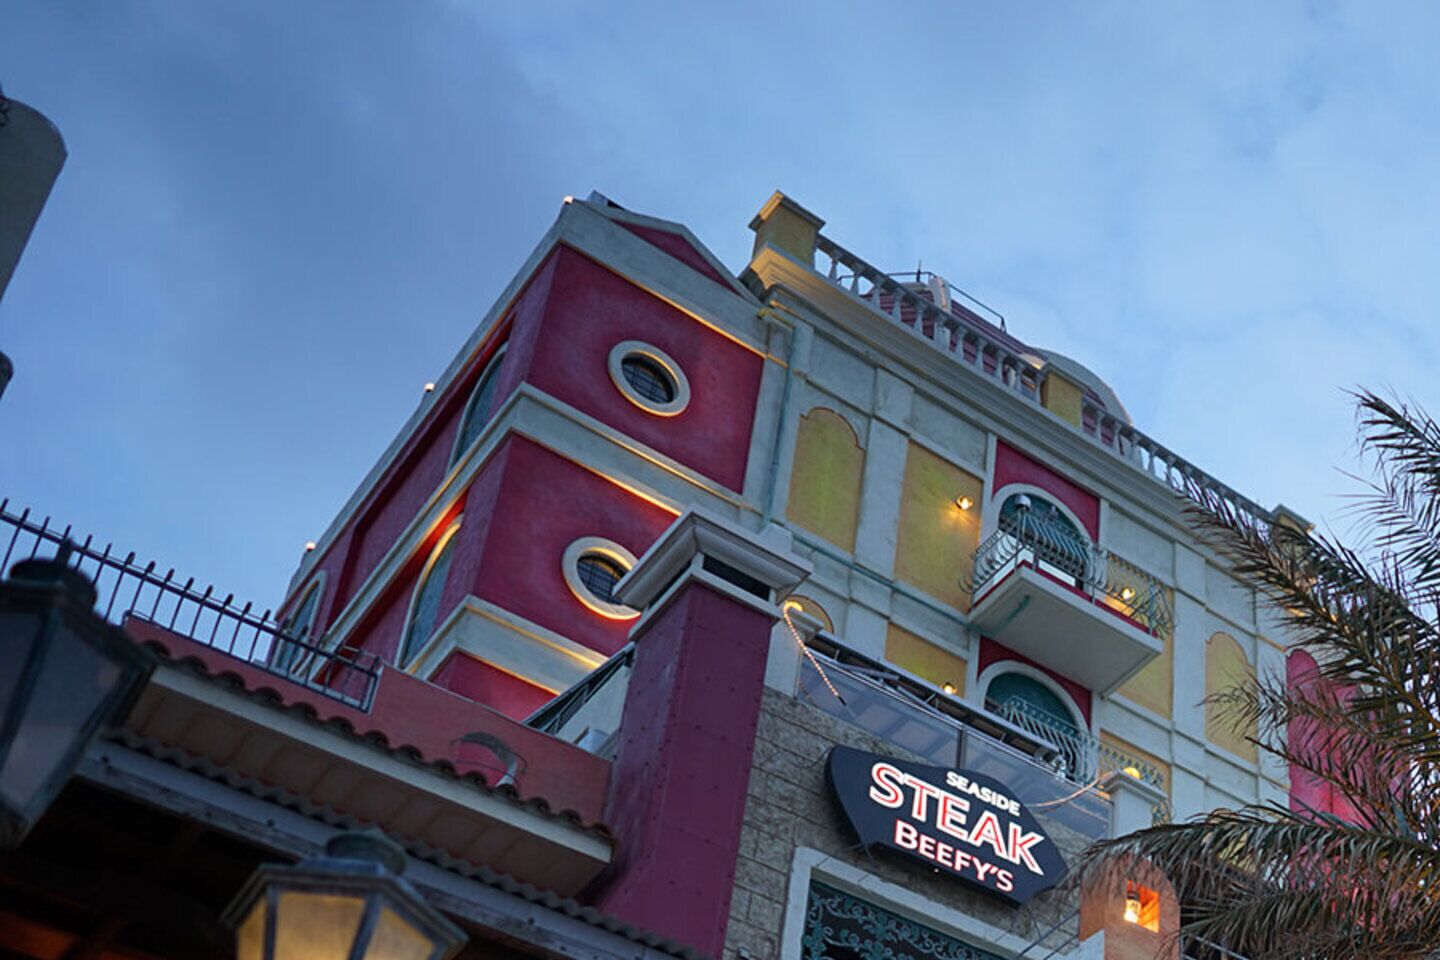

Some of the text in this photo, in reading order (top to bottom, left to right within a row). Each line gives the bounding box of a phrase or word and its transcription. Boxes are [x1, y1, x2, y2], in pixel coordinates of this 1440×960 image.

[869, 762, 1045, 876] STEAK
[946, 771, 1020, 817] SEASIDE
[894, 818, 1014, 893] BEEFY'S
